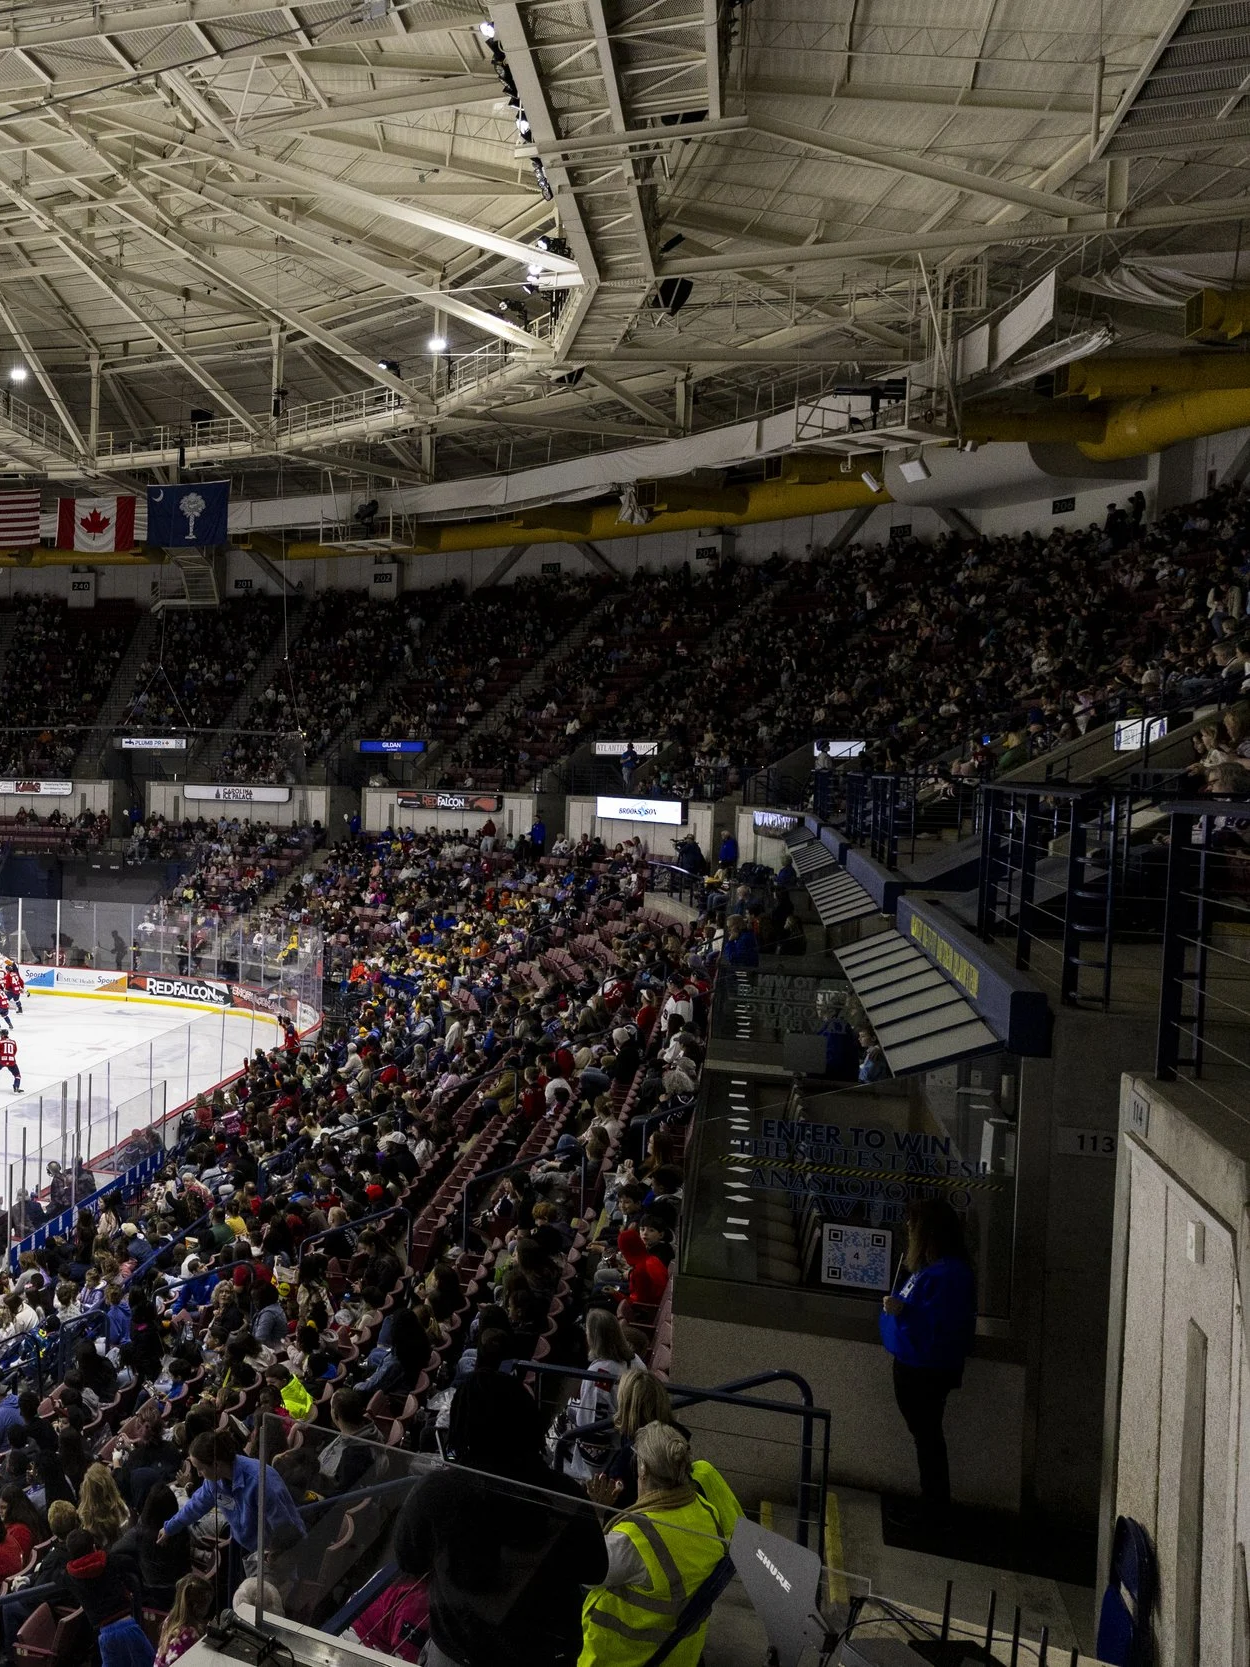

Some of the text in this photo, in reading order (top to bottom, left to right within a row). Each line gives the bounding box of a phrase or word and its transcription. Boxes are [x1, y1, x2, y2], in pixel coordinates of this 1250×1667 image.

[375, 574, 391, 582] 202
[596, 744, 627, 752] ATLANTIC
[422, 795, 465, 807] REDFALCON
[25, 969, 46, 979] Sports
[97, 975, 118, 984] Sports
[146, 977, 217, 1000] REDFALCON
[3, 1043, 14, 1054] 10
[1133, 1100, 1143, 1127] 114
[762, 1119, 950, 1156] ENTER TO WIN
[1077, 1134, 1115, 1153] 113
[736, 1138, 788, 1159] THE
[791, 1193, 908, 1222] LAW FIR
[853, 1252, 859, 1260] 4
[756, 1549, 792, 1593] SHURE
